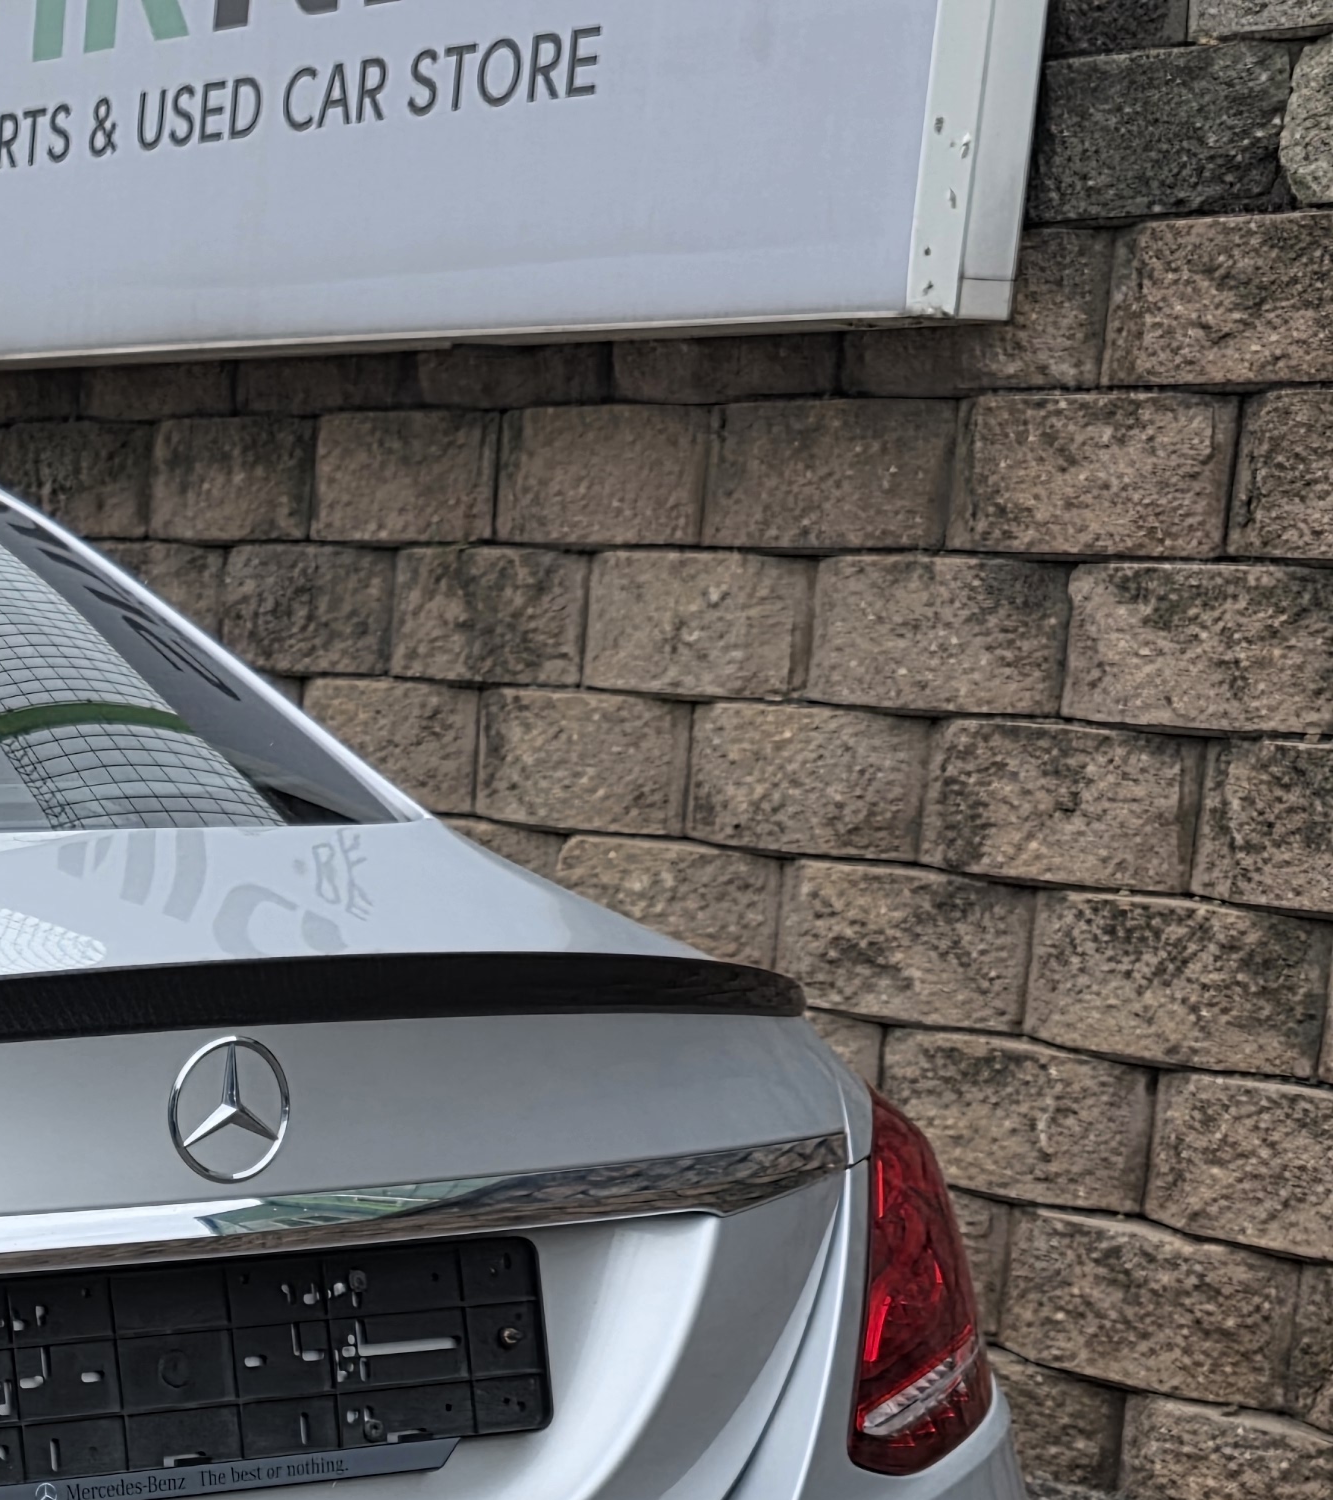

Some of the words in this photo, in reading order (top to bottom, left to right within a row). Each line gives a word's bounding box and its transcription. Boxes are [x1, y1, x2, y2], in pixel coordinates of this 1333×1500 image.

[88, 97, 117, 157] &
[137, 76, 262, 151] USED
[283, 57, 386, 132] CAR
[407, 24, 603, 117] STORE
[198, 1469, 226, 1488] The
[231, 1465, 262, 1483] best
[267, 1465, 282, 1480] or
[287, 1456, 349, 1478] nothing.
